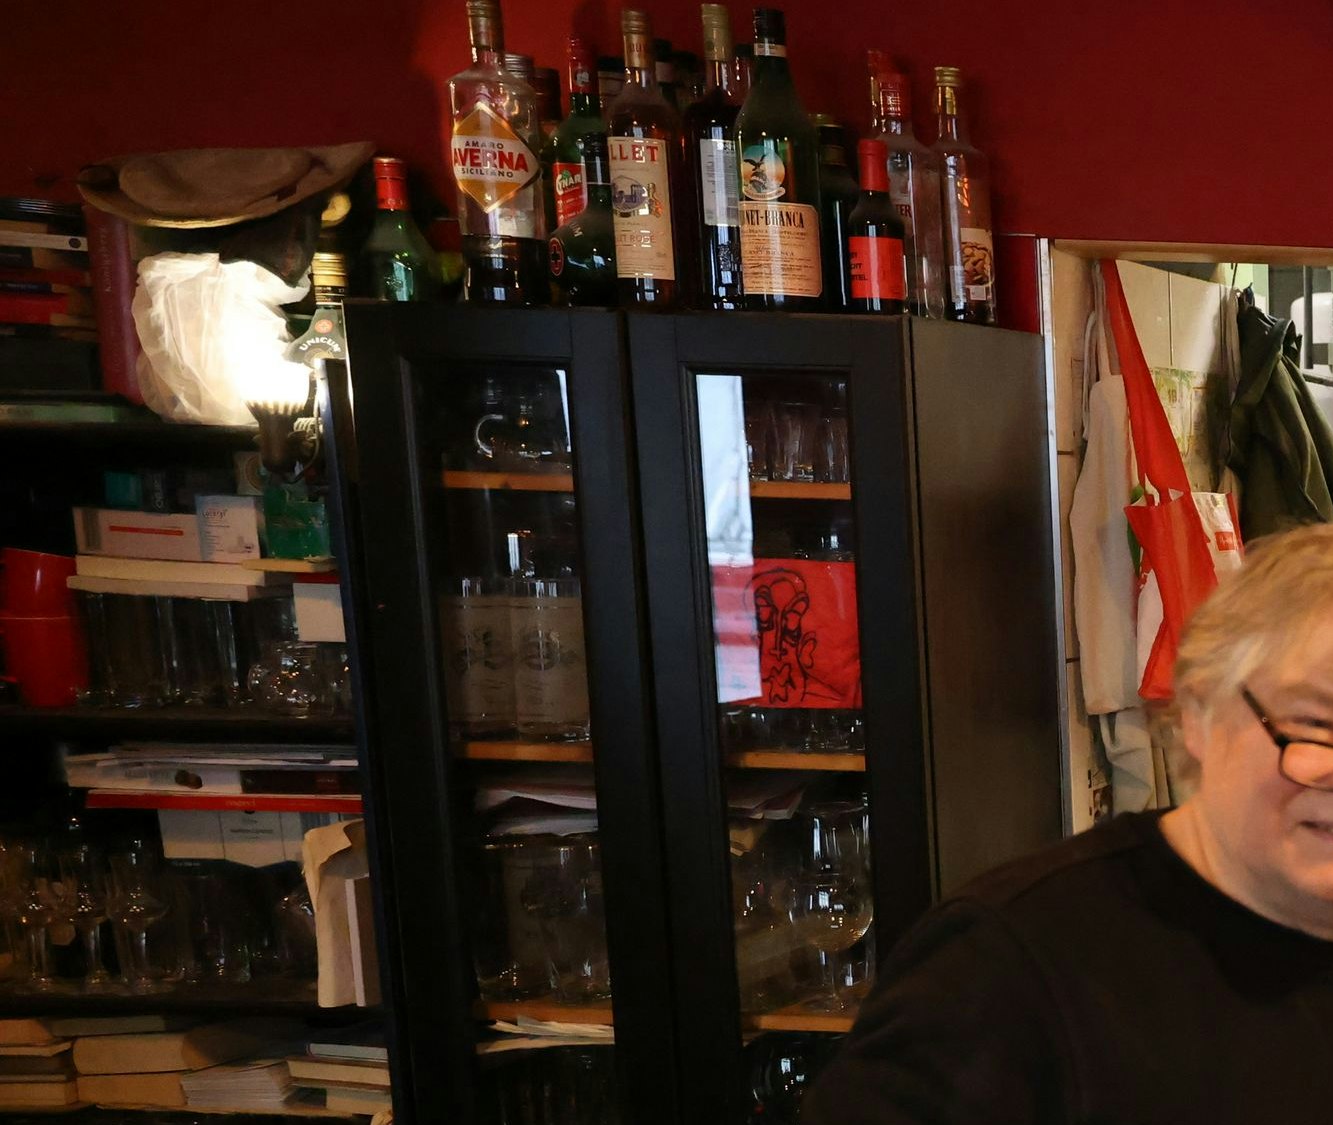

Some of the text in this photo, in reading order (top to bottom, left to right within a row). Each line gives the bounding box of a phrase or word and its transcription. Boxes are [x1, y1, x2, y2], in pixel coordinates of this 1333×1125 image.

[464, 140, 504, 150] AMARO
[453, 147, 529, 173] AVERNA
[461, 167, 514, 178] SICILIANO
